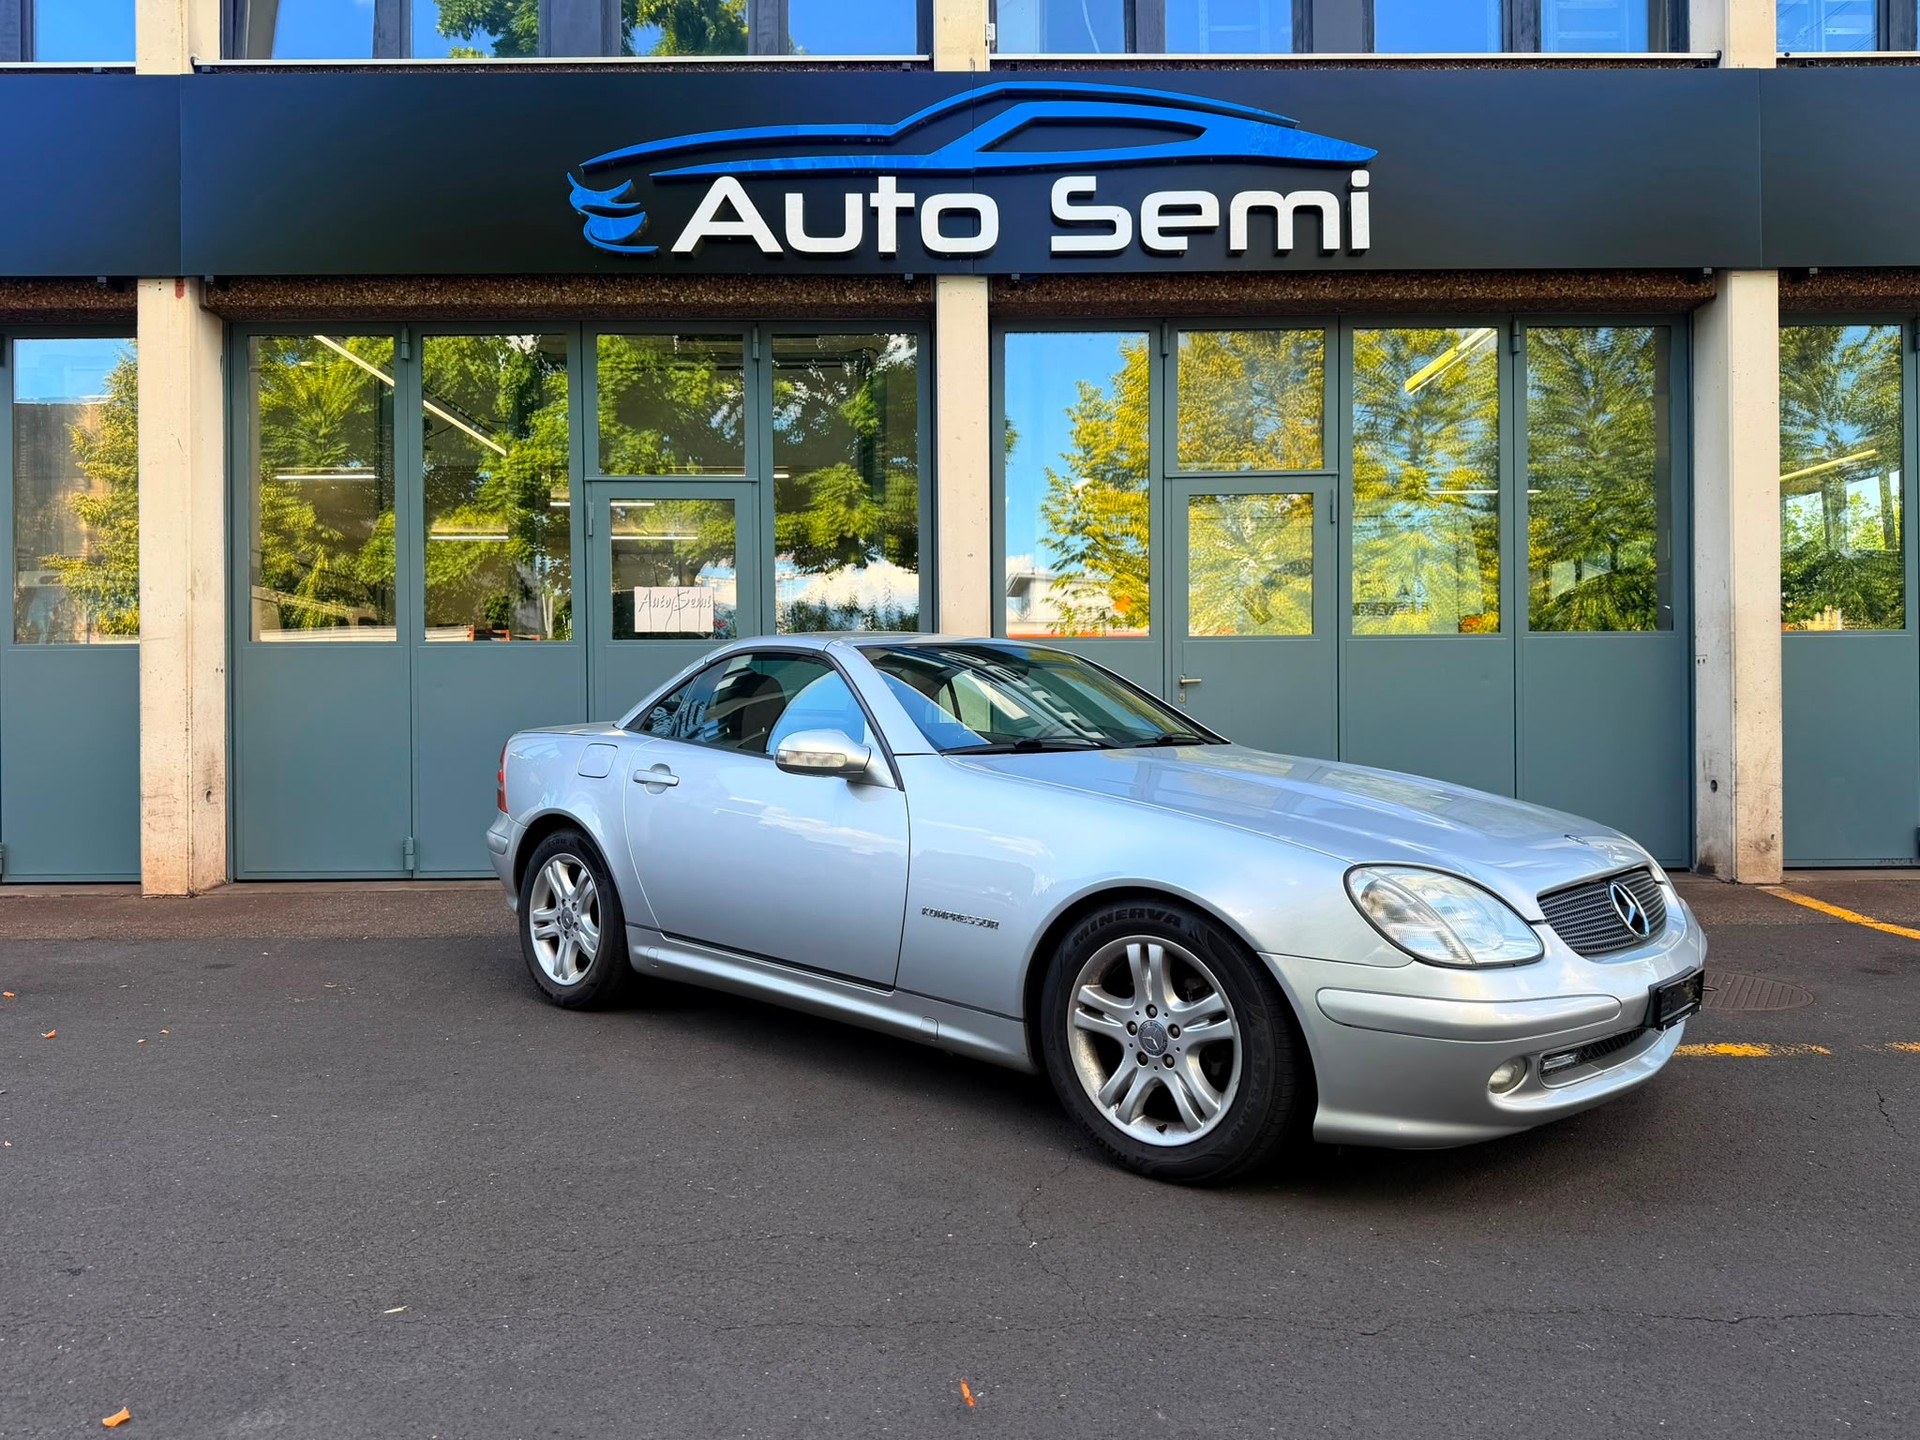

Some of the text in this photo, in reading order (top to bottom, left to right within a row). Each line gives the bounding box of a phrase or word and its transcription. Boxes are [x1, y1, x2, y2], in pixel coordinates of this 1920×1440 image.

[671, 169, 1370, 253] Auto Semi
[921, 906, 999, 930] KOMPRESSOR
[1072, 907, 1182, 945] MINERVA
